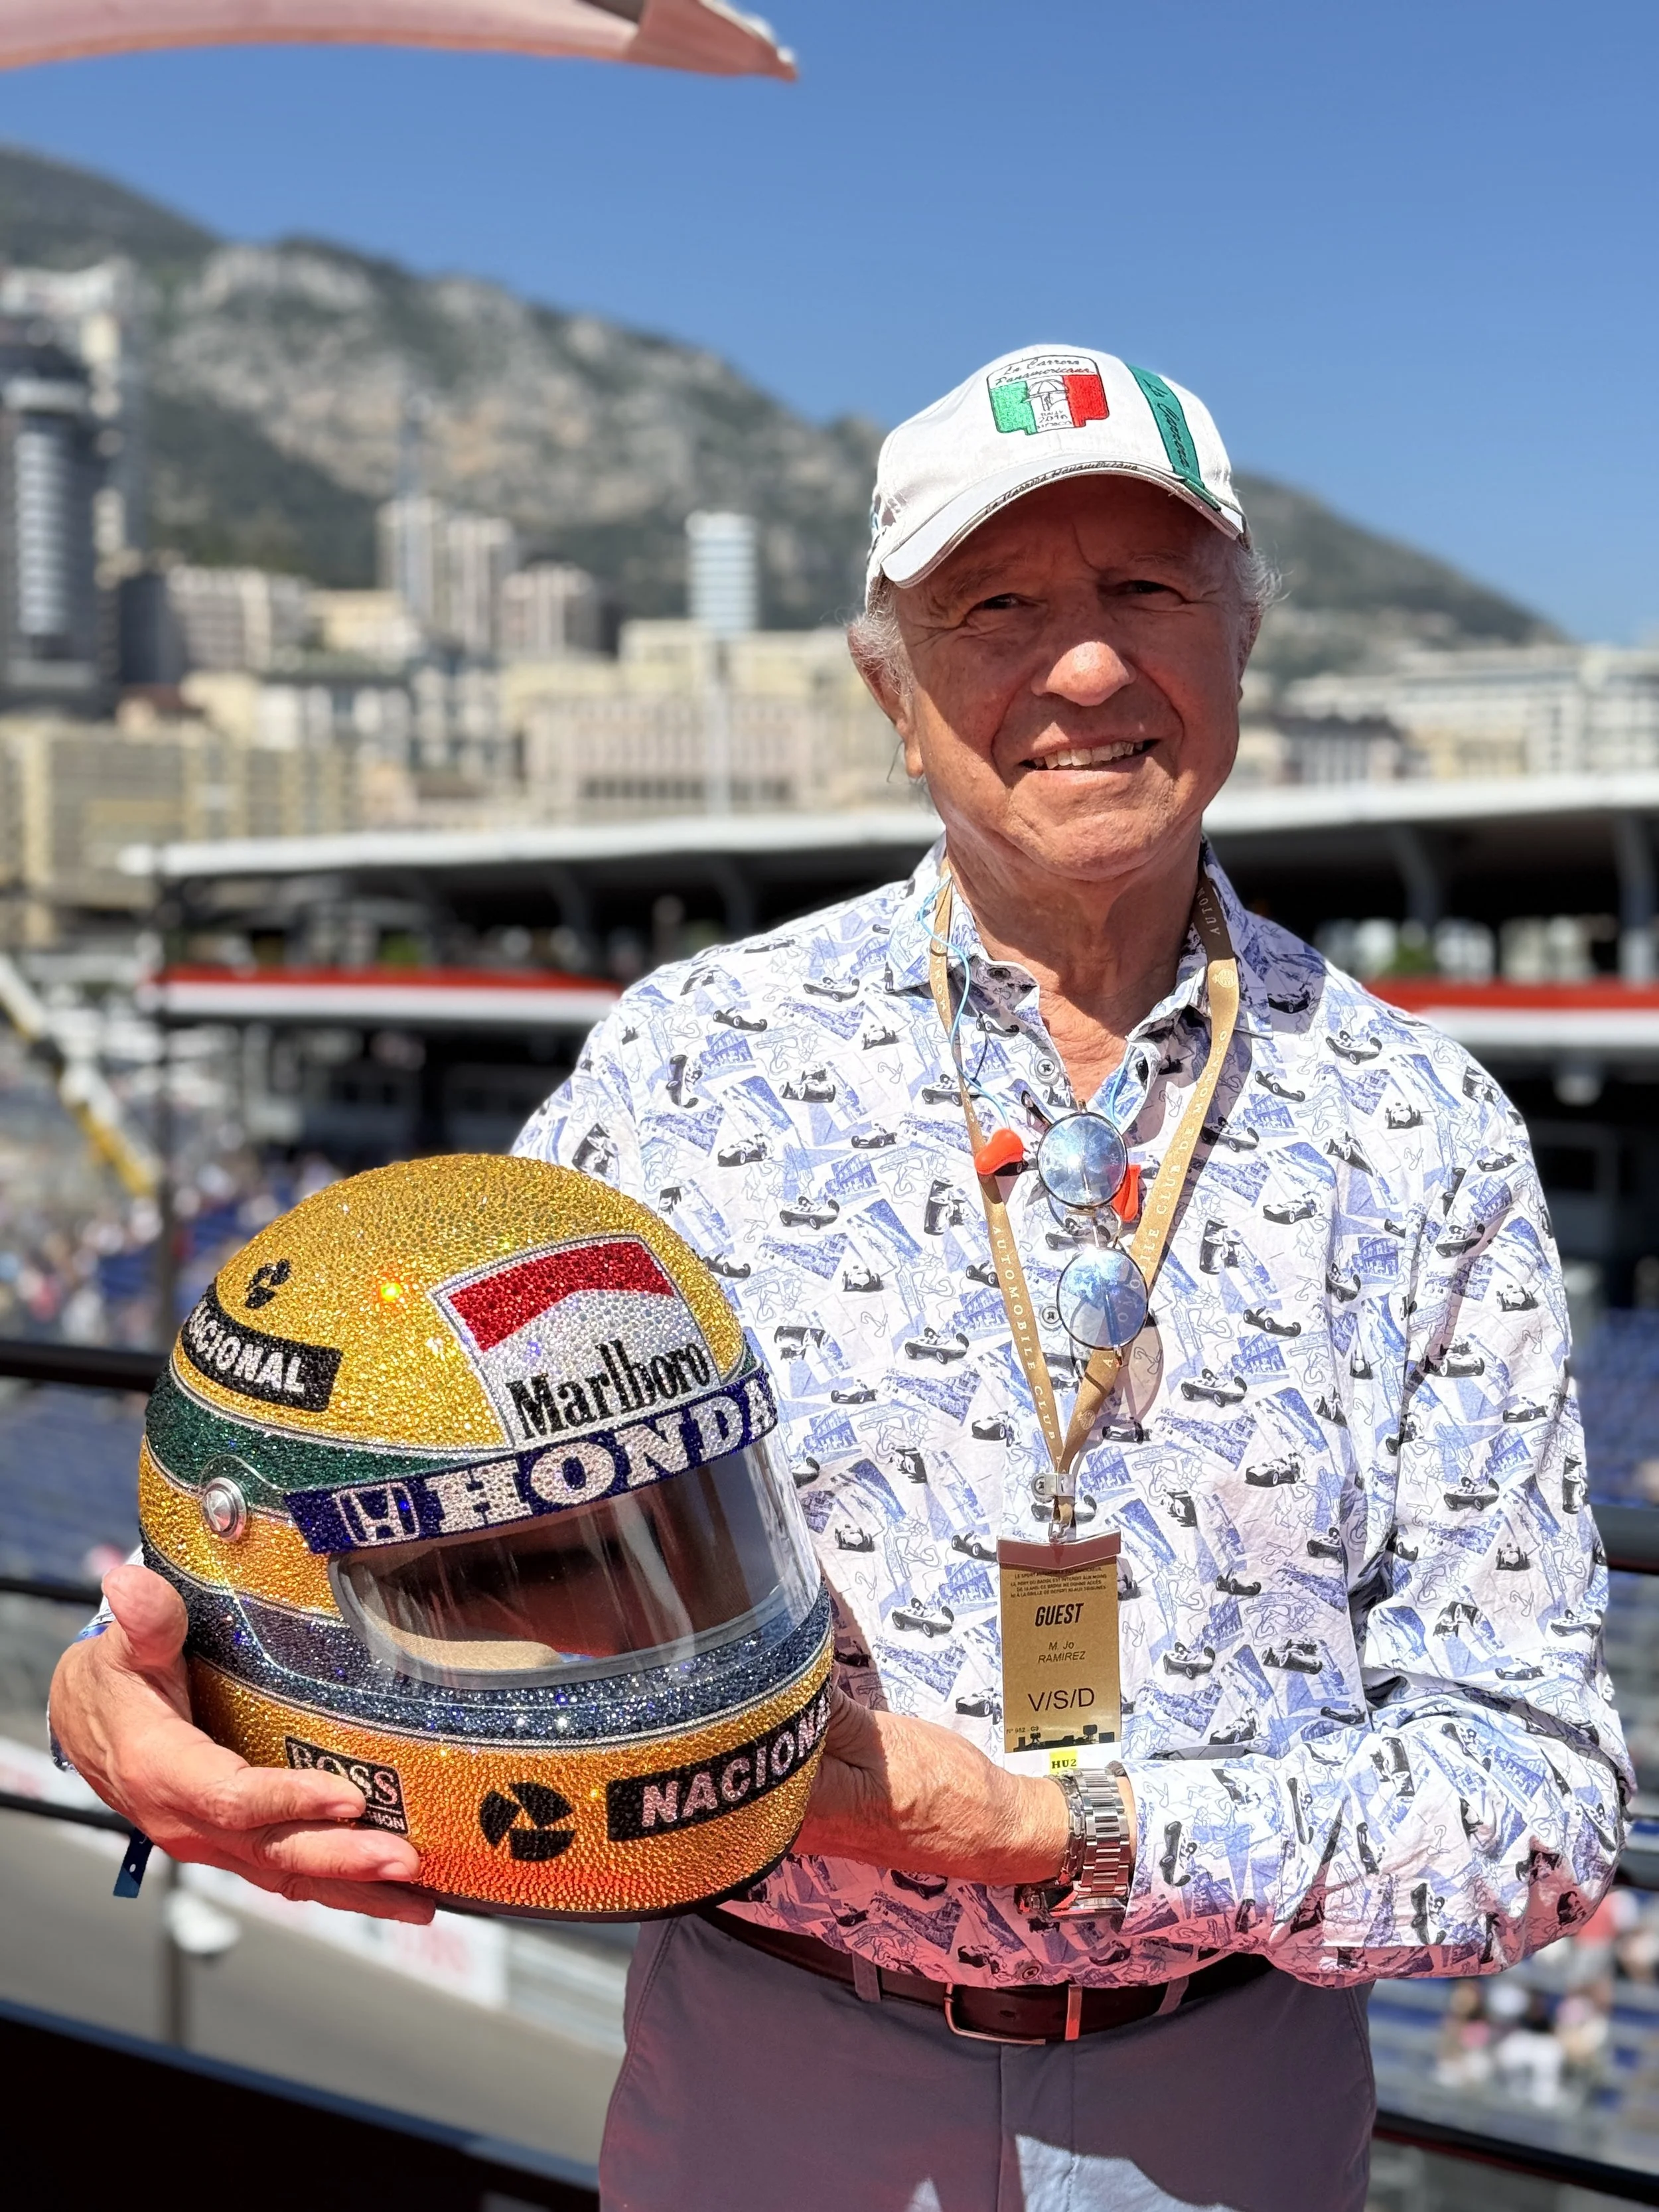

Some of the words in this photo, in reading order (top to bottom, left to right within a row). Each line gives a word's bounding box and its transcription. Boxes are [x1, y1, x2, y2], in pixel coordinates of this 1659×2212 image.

[992, 1225, 1036, 1370] AUTOMOBILE
[1034, 1385, 1056, 1440] CLUB
[506, 1339, 710, 1439] Marlboro
[424, 1378, 775, 1534] HONDA
[1035, 1602, 1085, 1627] GUEST
[1038, 1651, 1086, 1664] RAMIREZ
[1027, 1688, 1095, 1712] V/S/D
[1051, 1758, 1077, 1769] HU2
